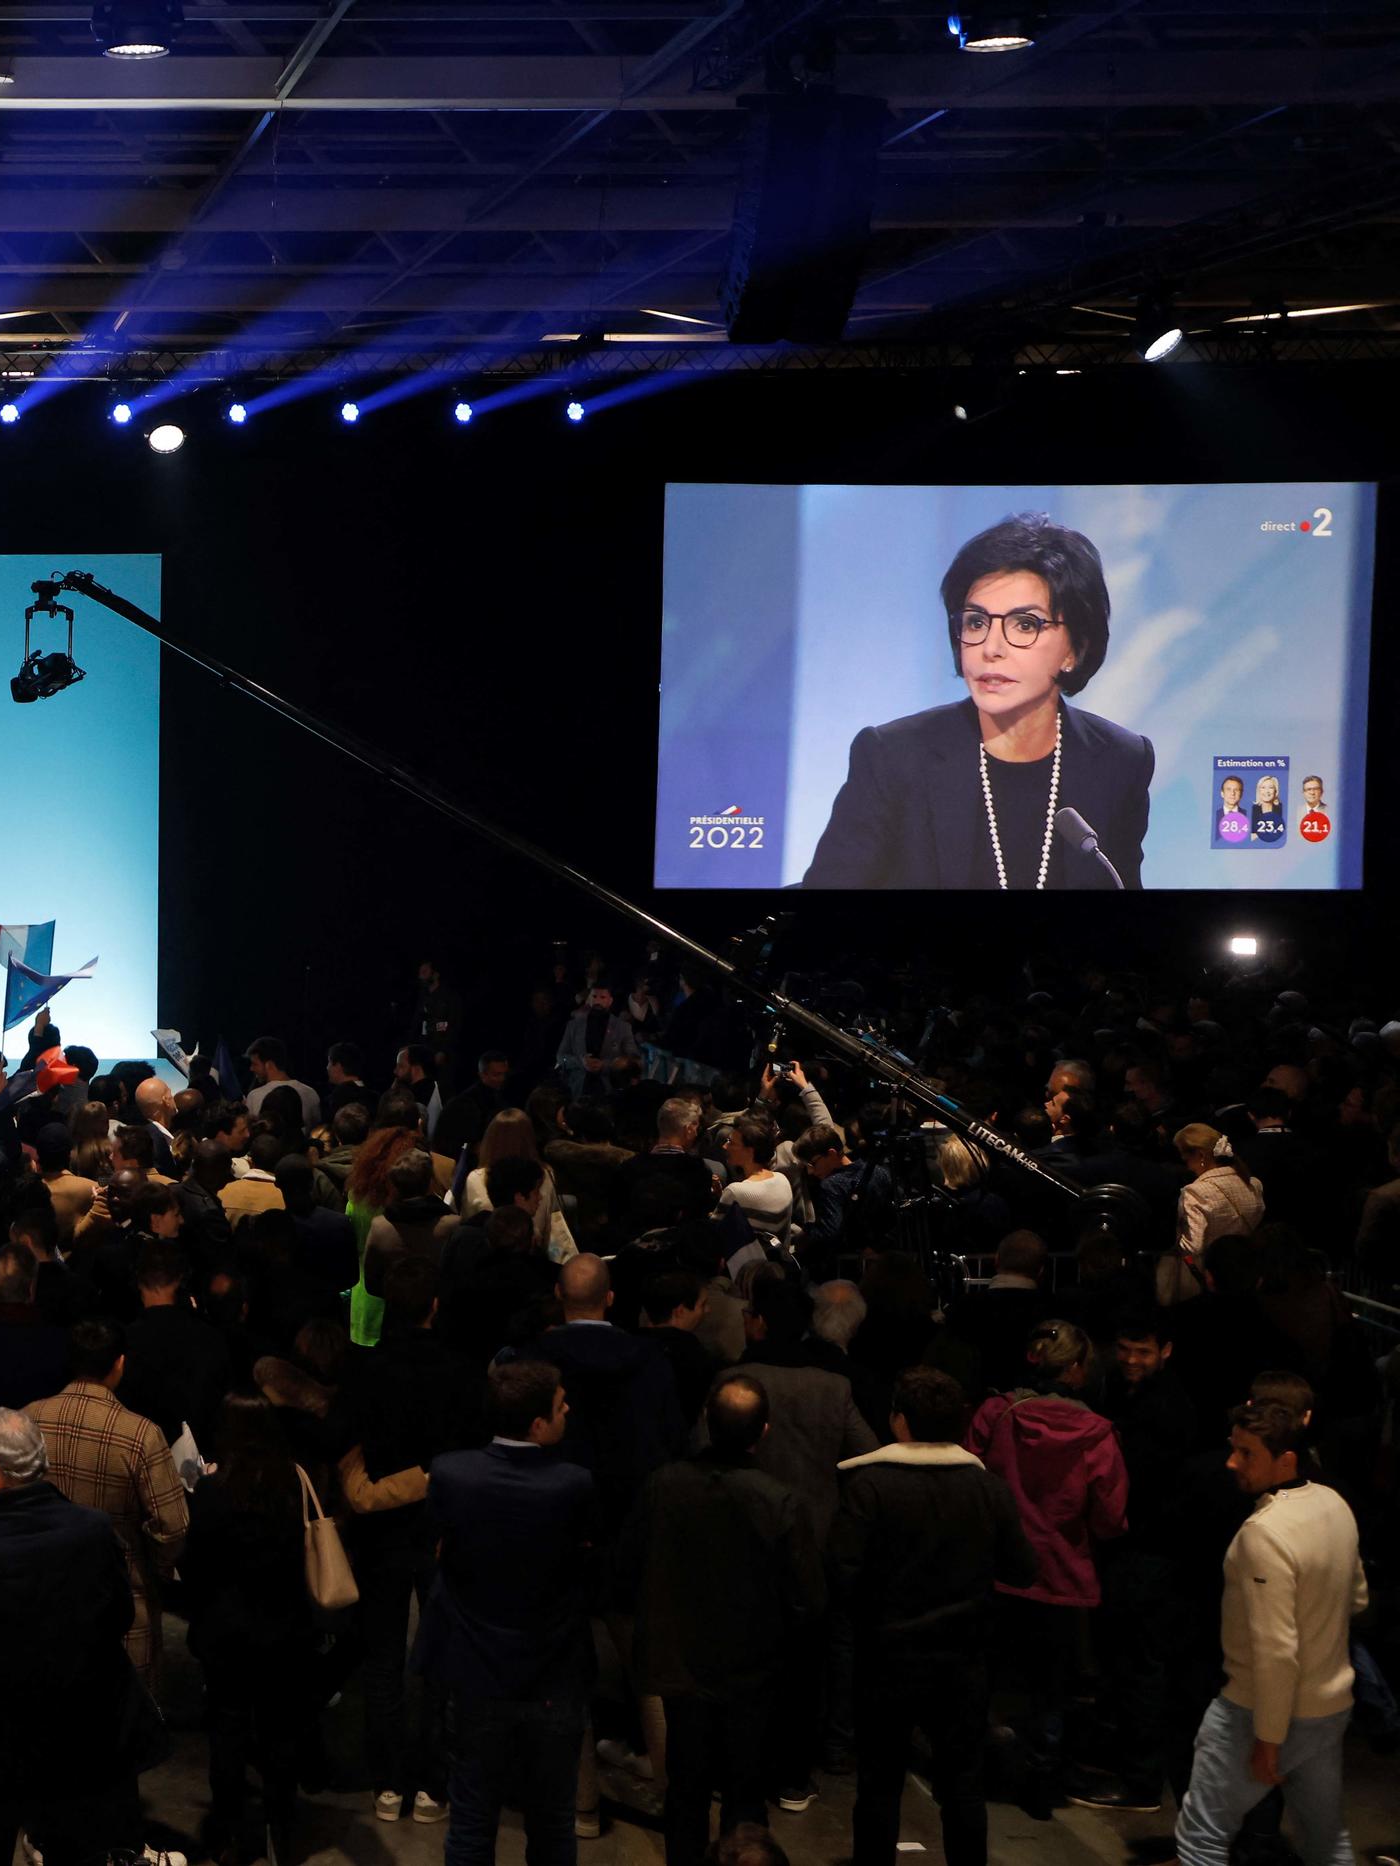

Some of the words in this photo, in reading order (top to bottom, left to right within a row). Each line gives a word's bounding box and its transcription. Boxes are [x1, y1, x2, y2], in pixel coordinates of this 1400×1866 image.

[1260, 521, 1296, 532] direct
[1312, 507, 1333, 537] 2
[1217, 759, 1264, 768] Estimation
[1277, 759, 1286, 768] %
[689, 815, 765, 825] PRÉSIDENTIELLE
[1222, 821, 1249, 833] 28,4
[1257, 821, 1284, 834] 23,4
[1303, 821, 1329, 833] 21,1
[689, 827, 764, 848] 2022
[967, 1121, 1025, 1162] LITECAM
